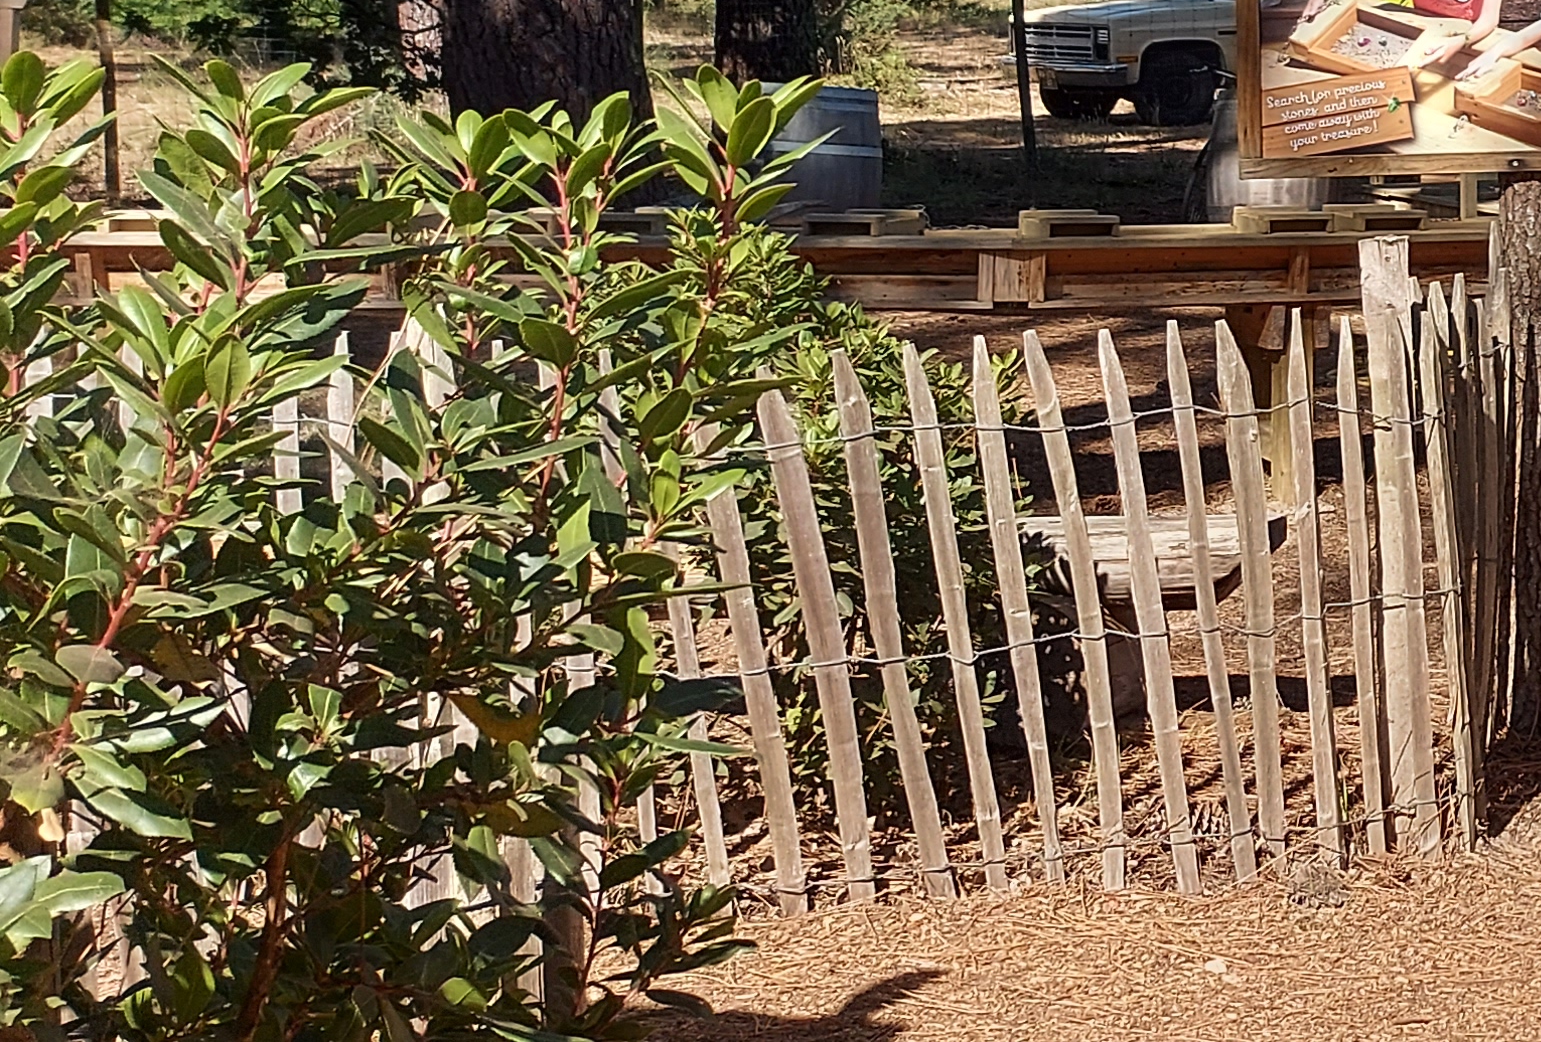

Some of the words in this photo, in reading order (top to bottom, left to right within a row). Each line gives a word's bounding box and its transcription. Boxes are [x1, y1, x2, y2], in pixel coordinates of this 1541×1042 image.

[1266, 92, 1312, 109] Search
[1334, 79, 1387, 98] precious
[1280, 107, 1319, 122] stones
[1323, 99, 1347, 114] and
[1349, 96, 1379, 110] then
[1284, 120, 1318, 135] come
[1318, 114, 1353, 129] away
[1353, 107, 1381, 122] with
[1289, 135, 1319, 152] your
